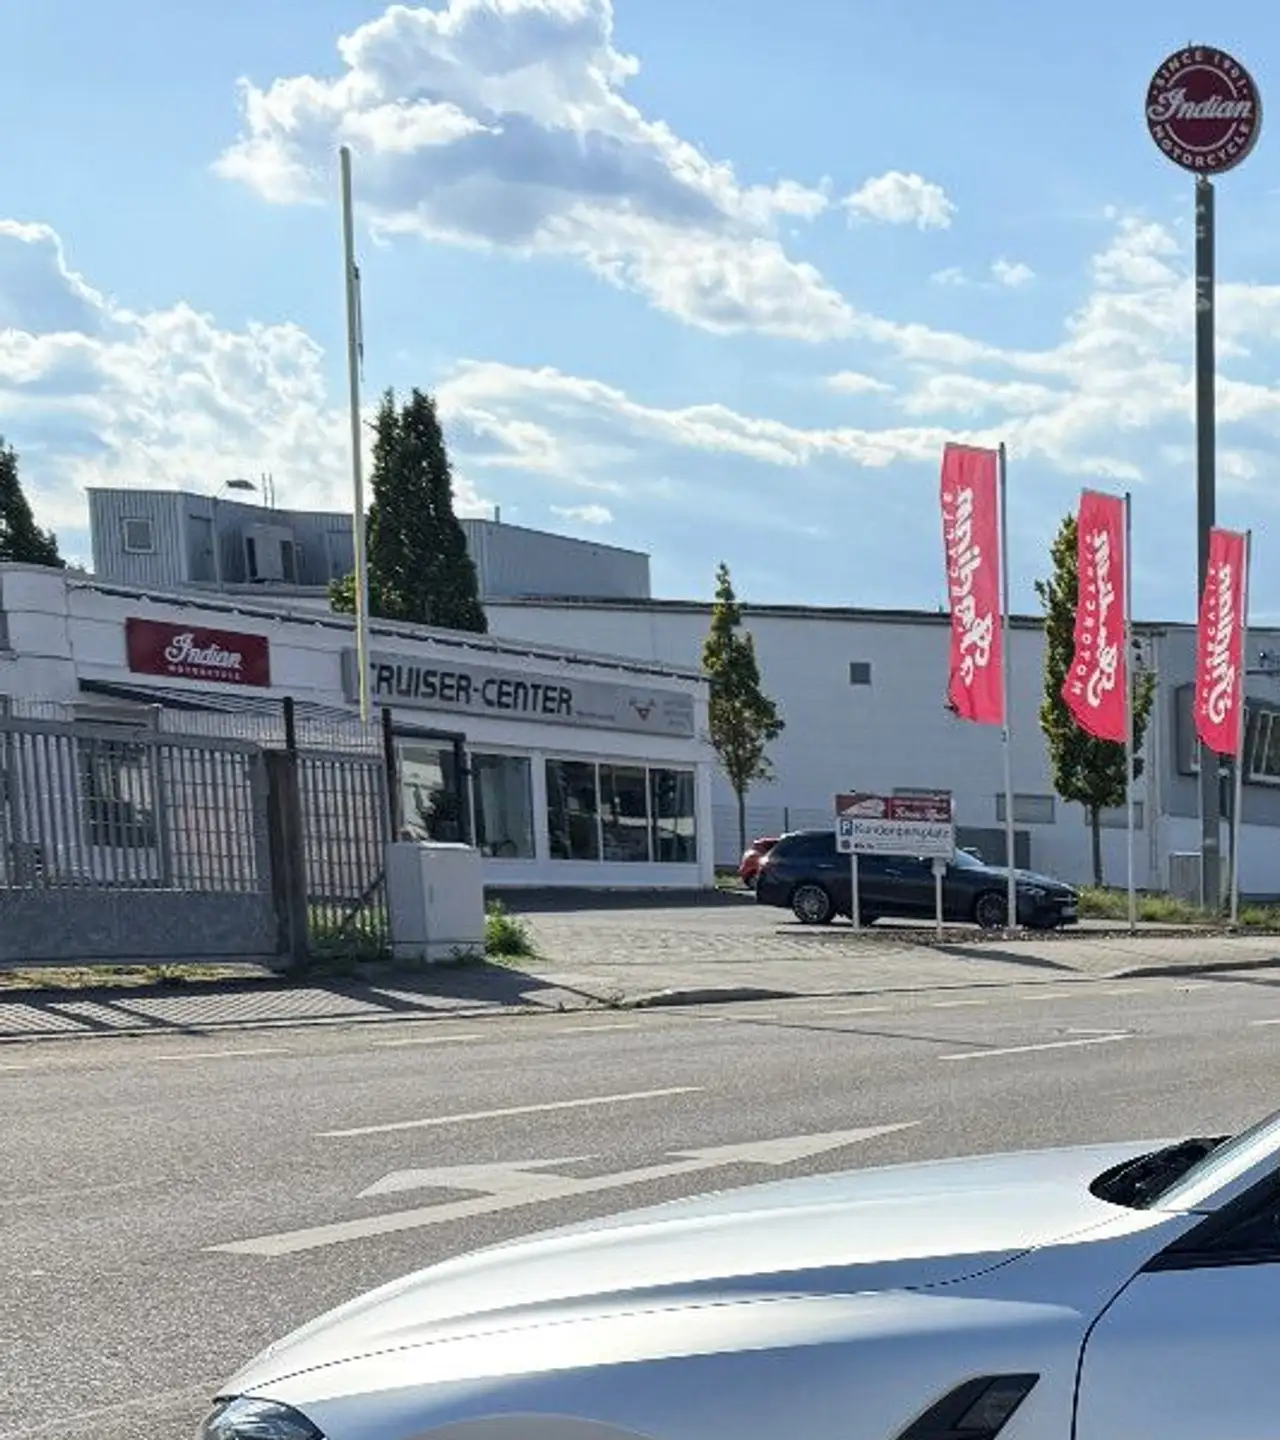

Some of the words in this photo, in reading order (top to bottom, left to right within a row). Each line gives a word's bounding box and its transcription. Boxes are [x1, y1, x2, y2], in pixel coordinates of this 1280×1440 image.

[1147, 87, 1253, 121] Indian
[1152, 122, 1250, 168] MOTORCYCLE
[164, 632, 243, 669] Indian
